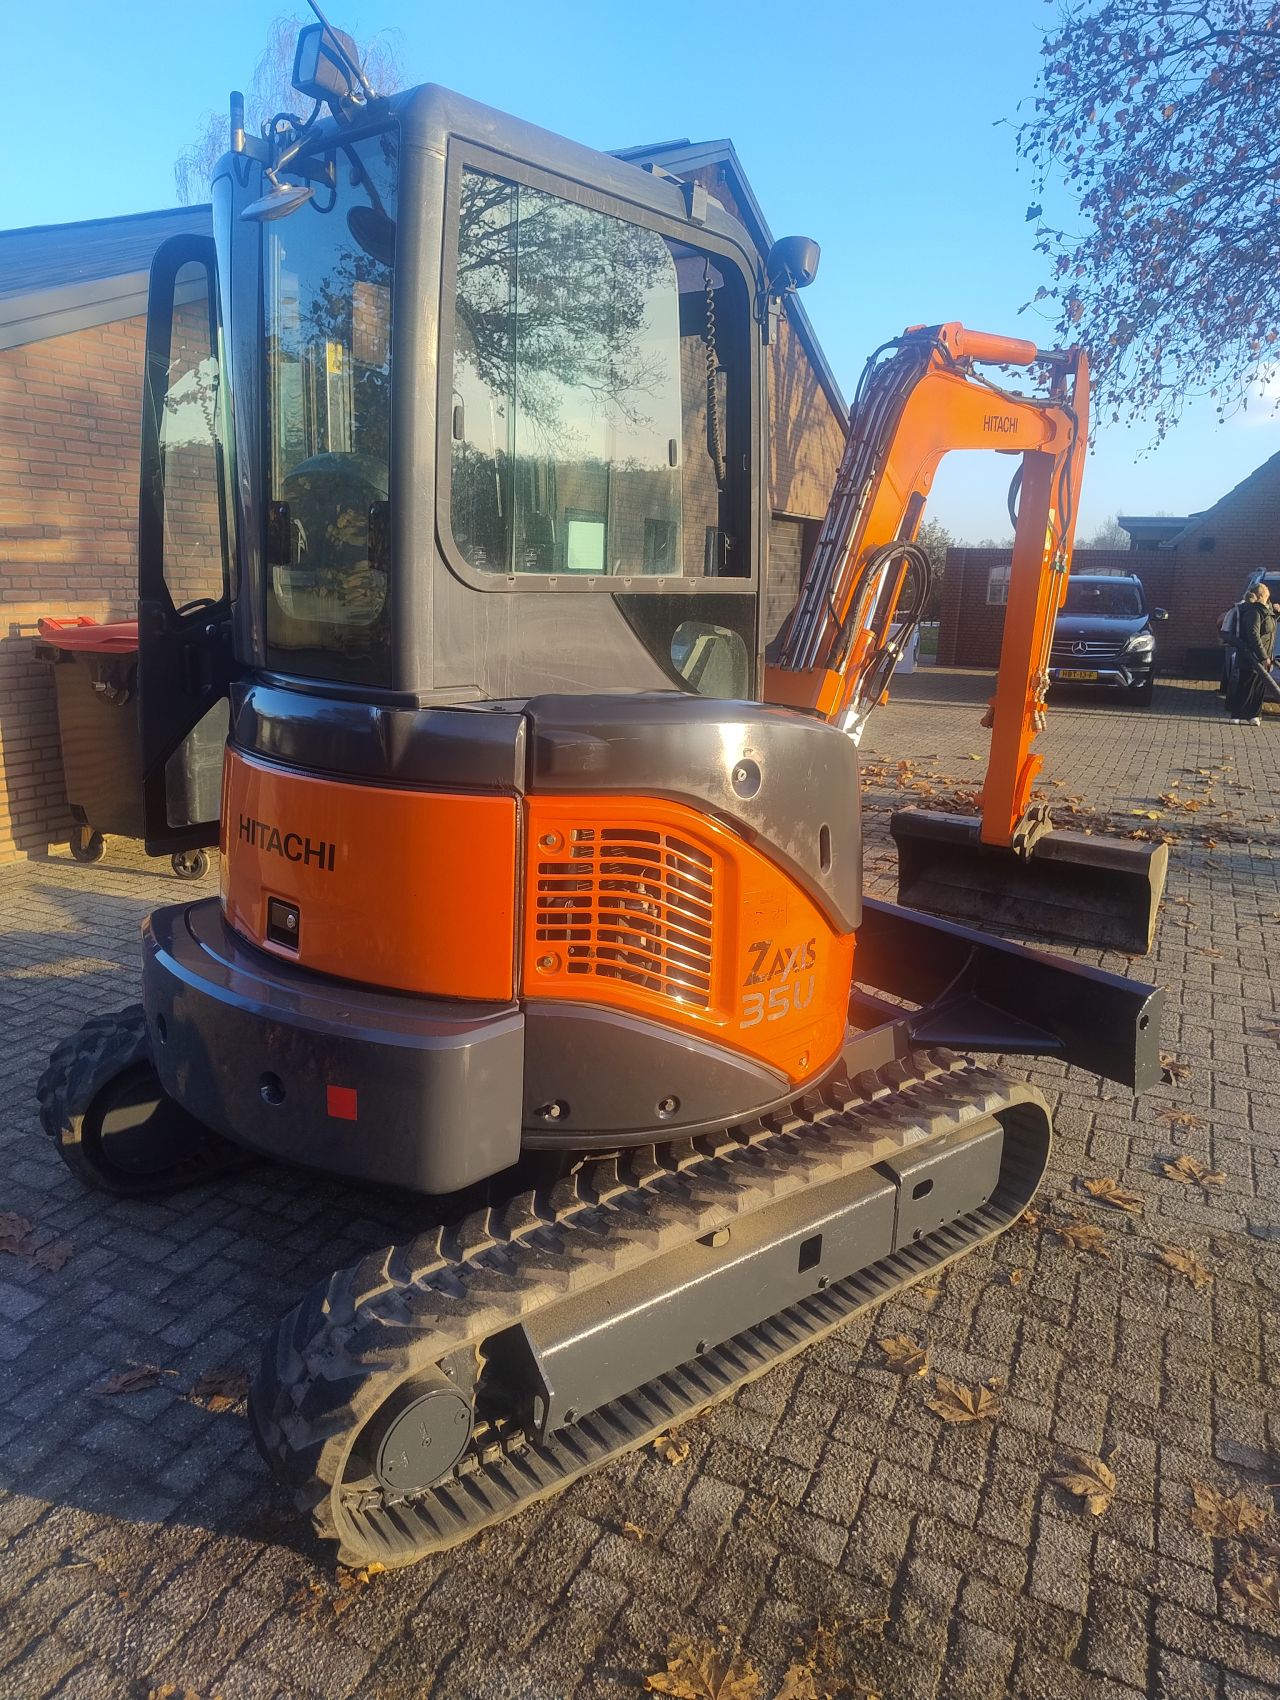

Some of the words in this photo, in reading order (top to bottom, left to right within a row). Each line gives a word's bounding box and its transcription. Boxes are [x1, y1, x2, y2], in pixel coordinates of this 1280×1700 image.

[983, 415, 1019, 433] HITACHI
[239, 813, 336, 872] HITACHI
[740, 975, 815, 1029] 35U
